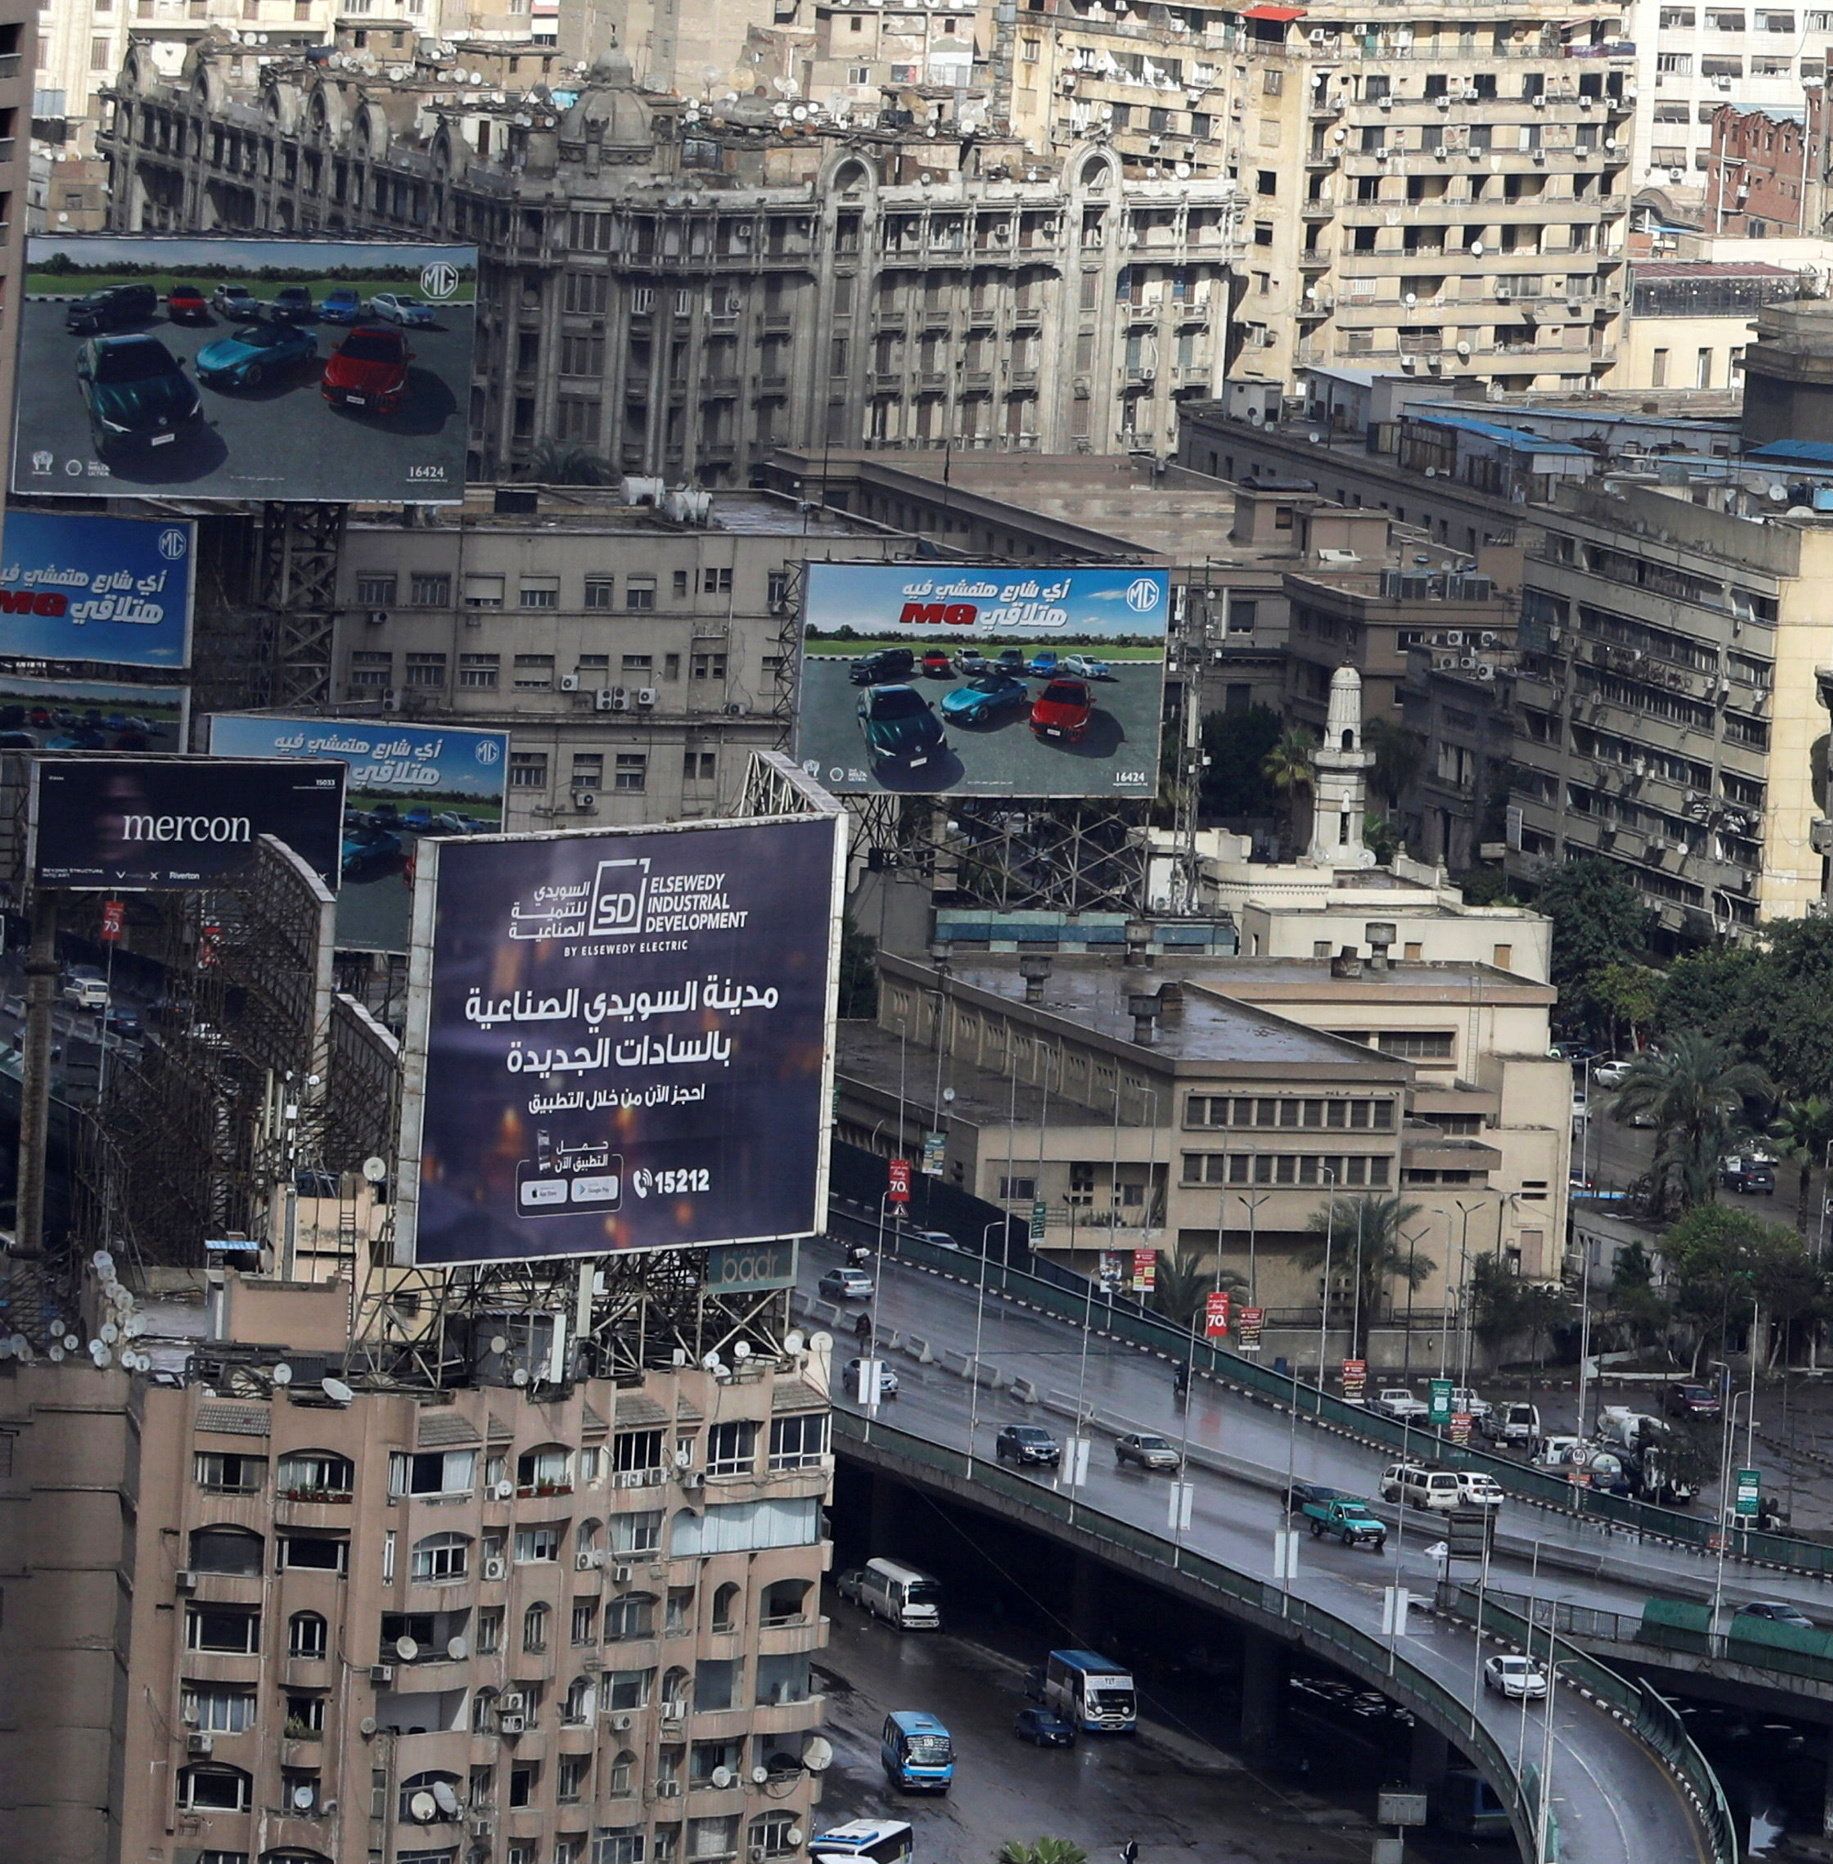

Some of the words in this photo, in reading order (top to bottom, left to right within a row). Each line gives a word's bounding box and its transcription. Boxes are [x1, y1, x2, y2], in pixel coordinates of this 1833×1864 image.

[408, 466, 445, 478] 16424
[159, 529, 187, 560] MG
[902, 579, 934, 599] فيه
[935, 578, 998, 599] هتمشي
[1000, 579, 1039, 603] شارع
[1042, 578, 1072, 603] أي
[1126, 578, 1160, 613] MG
[70, 594, 164, 625] هتلاقي
[899, 602, 978, 625] MG
[979, 602, 1069, 632] هتلاقي
[274, 732, 302, 751] فيه
[306, 735, 370, 755] هتمشي
[372, 739, 411, 760] شارع
[411, 739, 444, 761] أي
[351, 760, 441, 787] هتلاقي
[1114, 772, 1145, 782] 16424
[122, 814, 252, 843] mercon
[168, 871, 200, 881] Riverton
[650, 873, 725, 894] ELSEWEDY
[534, 881, 590, 907] السويدي
[647, 893, 731, 913] INDUSTRIAL
[511, 901, 587, 922] للتنمية
[645, 911, 749, 933] DEVELOPMENT
[508, 921, 585, 943] الصناعية
[564, 946, 578, 957] BY
[582, 943, 636, 956] ELSEWEDY
[639, 940, 688, 953] ELECTRIC
[583, 980, 698, 1033] السويدي
[702, 974, 779, 1016] مدينة
[465, 987, 580, 1030] الصناعية
[506, 1037, 611, 1079] الجديدة
[615, 1030, 732, 1067] بالسادات
[528, 1091, 584, 1114] التطبيق
[586, 1089, 619, 1111] خلال
[621, 1088, 643, 1108] من
[645, 1084, 670, 1108] الآن
[671, 1083, 705, 1106] احجز
[654, 1168, 710, 1194] 15212
